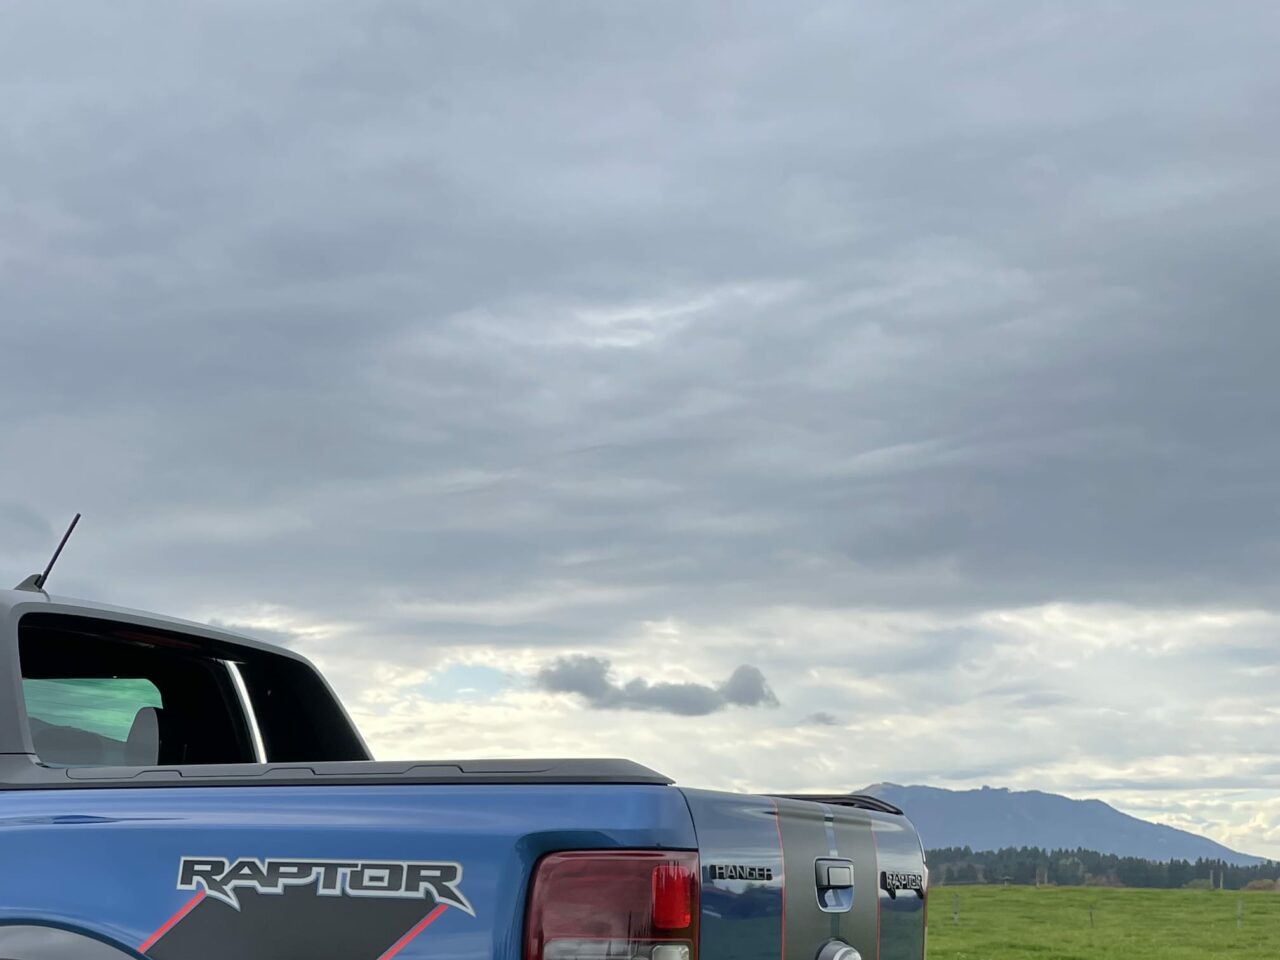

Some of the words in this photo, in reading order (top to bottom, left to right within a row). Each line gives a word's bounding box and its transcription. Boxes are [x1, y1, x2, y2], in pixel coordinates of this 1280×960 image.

[711, 864, 773, 881] RANGER
[880, 872, 924, 899] RAPTOR
[176, 856, 476, 917] RAPTOR
